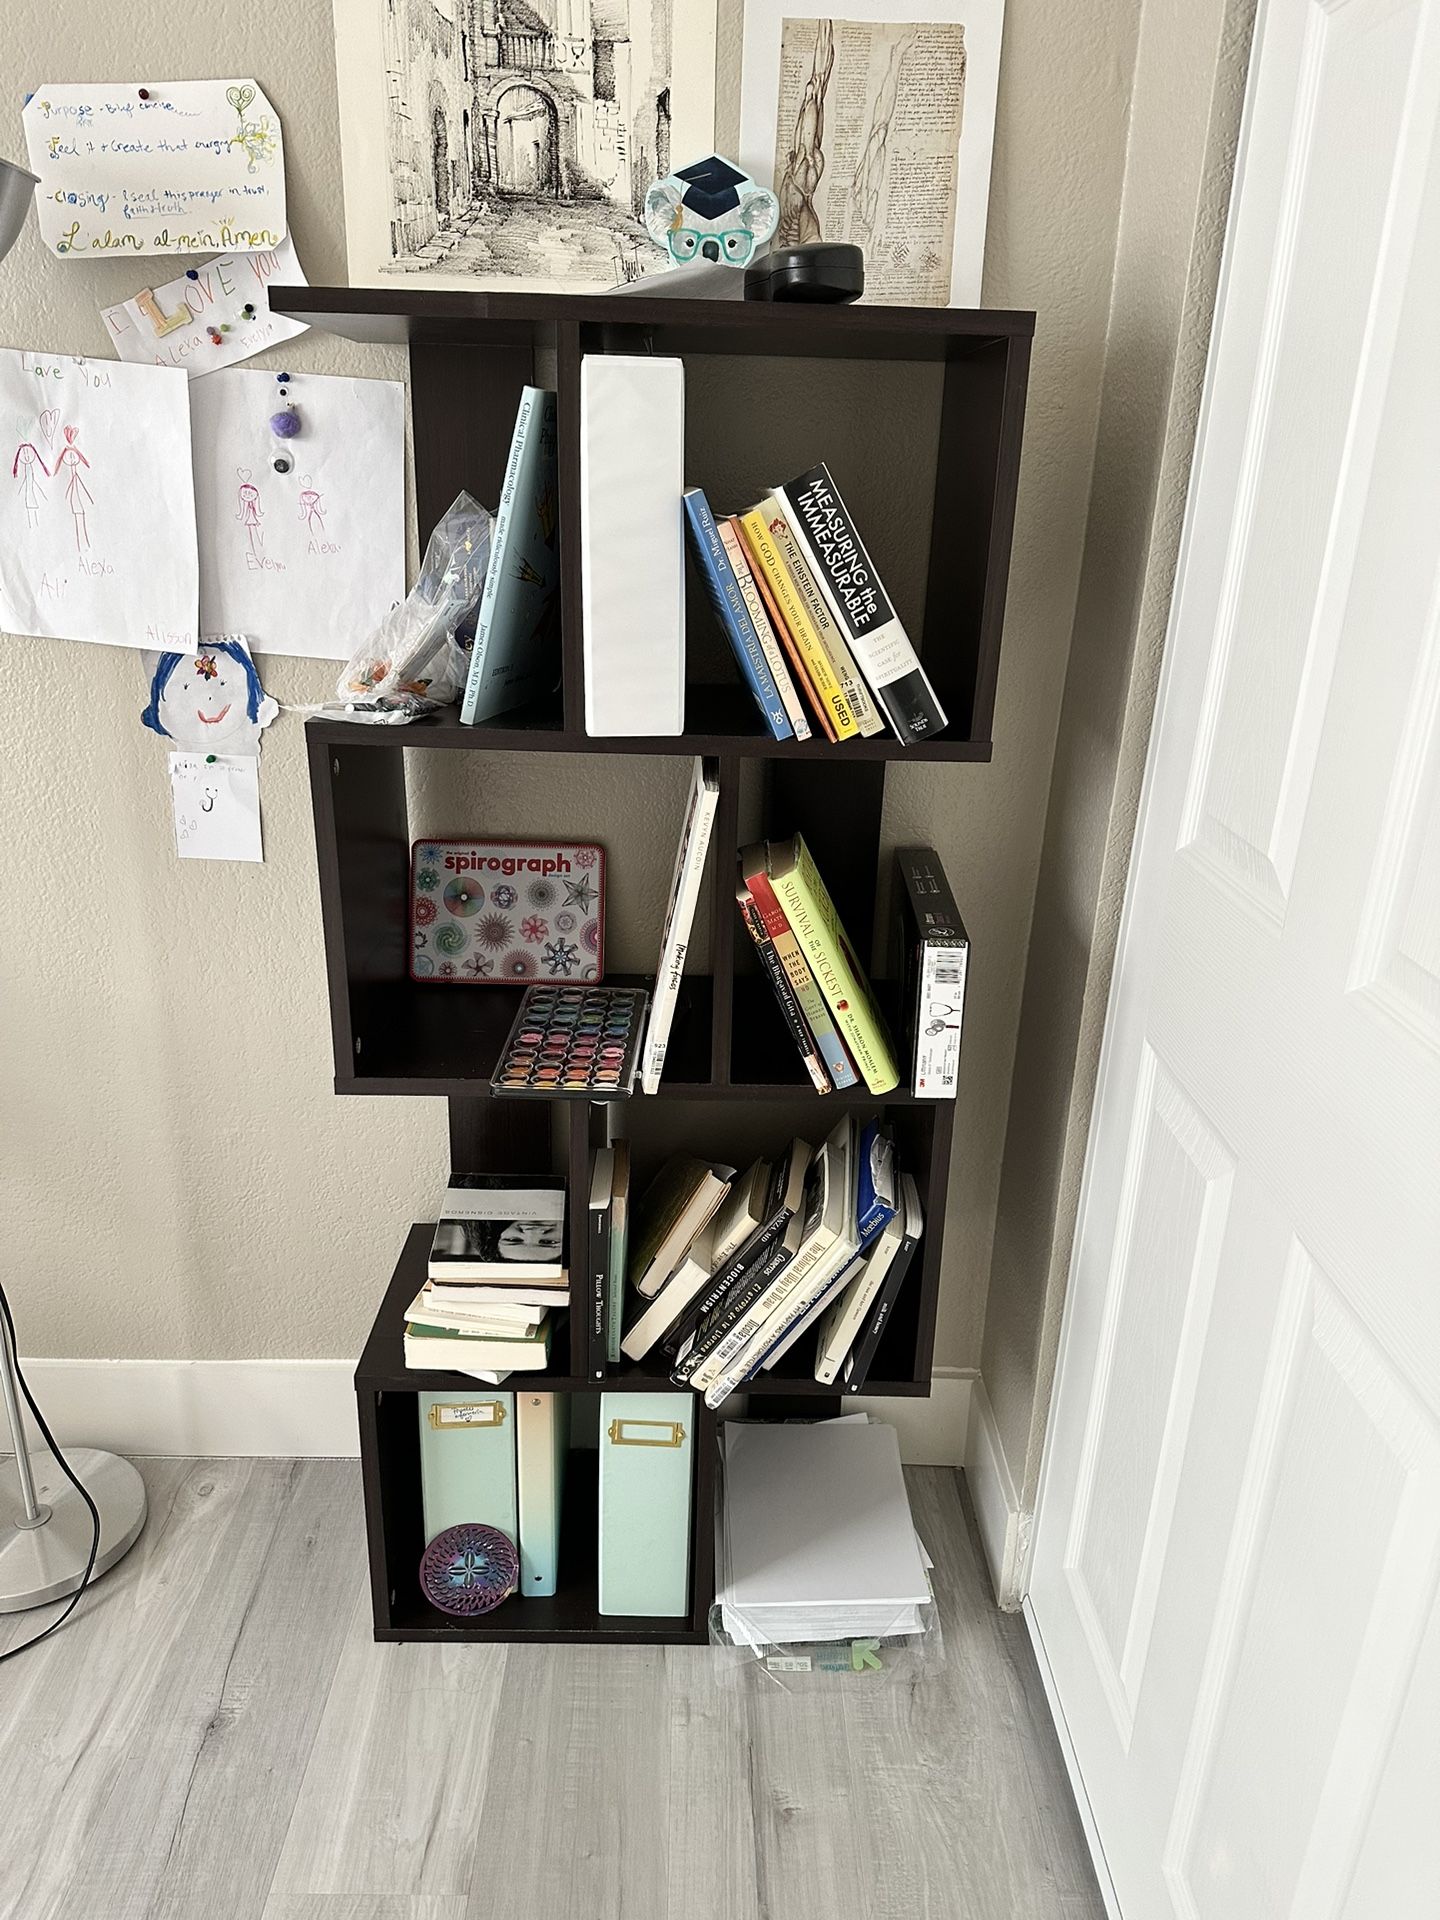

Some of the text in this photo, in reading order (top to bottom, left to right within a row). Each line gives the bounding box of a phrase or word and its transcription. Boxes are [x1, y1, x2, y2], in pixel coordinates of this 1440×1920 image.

[157, 138, 187, 152] that
[503, 402, 530, 505] Clinical Pharmacology
[498, 516, 506, 534] made
[698, 508, 726, 571] Dr. Miguel Ruiz
[810, 478, 877, 615] MEASURING the
[735, 560, 745, 574] The
[798, 492, 870, 628] IMMEASURABLE
[486, 577, 495, 598] simple
[751, 522, 812, 651] HOW GOD CHANGES YOUR BRAIN
[785, 541, 829, 629] THE EINSTEIN FACTOR
[737, 574, 776, 643] BLOOMING
[478, 623, 488, 644] James
[726, 583, 774, 698] LA MAESTRÍA DEL AMOR
[769, 655, 790, 692] LOTUS
[832, 695, 850, 726] USED
[694, 812, 710, 870] KEVYN AUCOIN
[444, 851, 571, 876] spirograph
[782, 882, 814, 936] SURVIVAL
[808, 940, 816, 951] THE
[814, 939, 820, 947] OF
[782, 950, 799, 961] WHEN
[788, 960, 800, 968] THE
[789, 966, 806, 978] BODY
[794, 975, 809, 986] SAYS
[814, 952, 842, 995] SICKEST
[766, 950, 795, 1016] The Bhagavad Gita
[853, 1025, 865, 1048] SHARON
[864, 1050, 877, 1073] MOALEM
[725, 1241, 736, 1252] The
[761, 1230, 771, 1242] MD
[764, 1254, 784, 1275] Cisneros
[762, 1242, 824, 1309] The Natural Way to Draw
[701, 1263, 743, 1312] BIOCENTRISM
[728, 1312, 736, 1320] de
[793, 1306, 801, 1314] MY
[880, 1302, 888, 1313] milk
[738, 1319, 758, 1337] Nicola
[774, 1325, 784, 1334] HAS
[872, 1322, 881, 1334] honey
[744, 1336, 772, 1368] MOTORCYCLE
